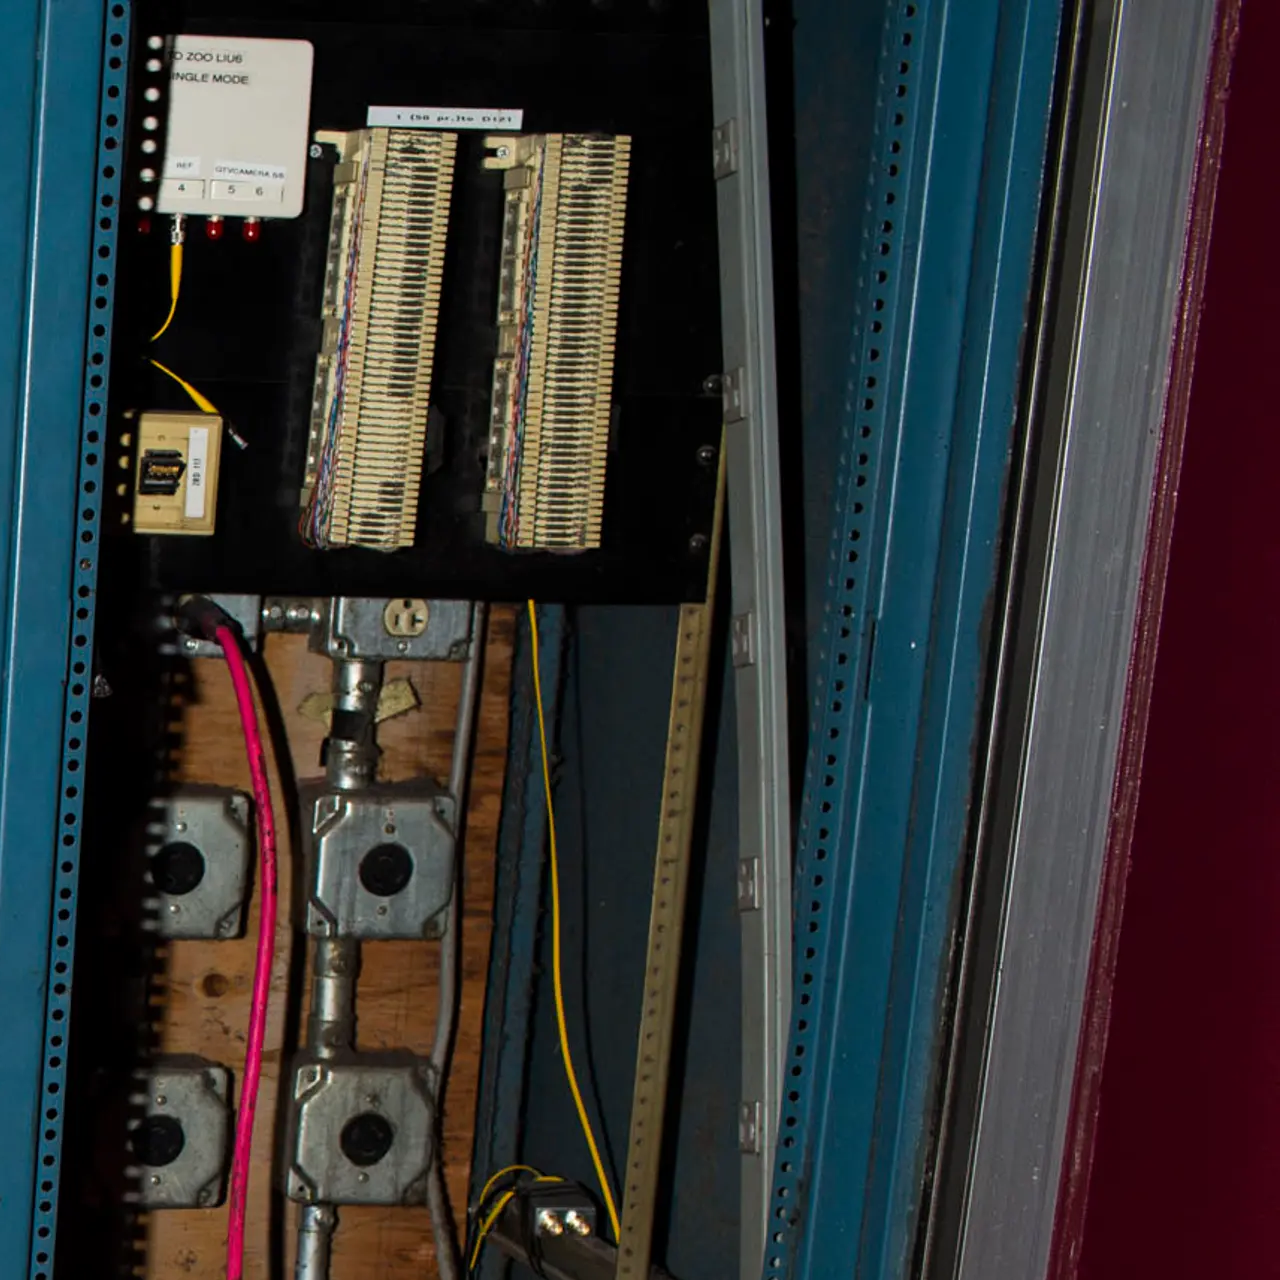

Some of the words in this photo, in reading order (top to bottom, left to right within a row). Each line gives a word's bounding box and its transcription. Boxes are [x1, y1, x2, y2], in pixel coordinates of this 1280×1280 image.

[171, 72, 209, 83] INGLE
[212, 74, 249, 85] MODE
[178, 183, 186, 192] 4
[227, 185, 237, 195] 5
[255, 186, 265, 197] 6
